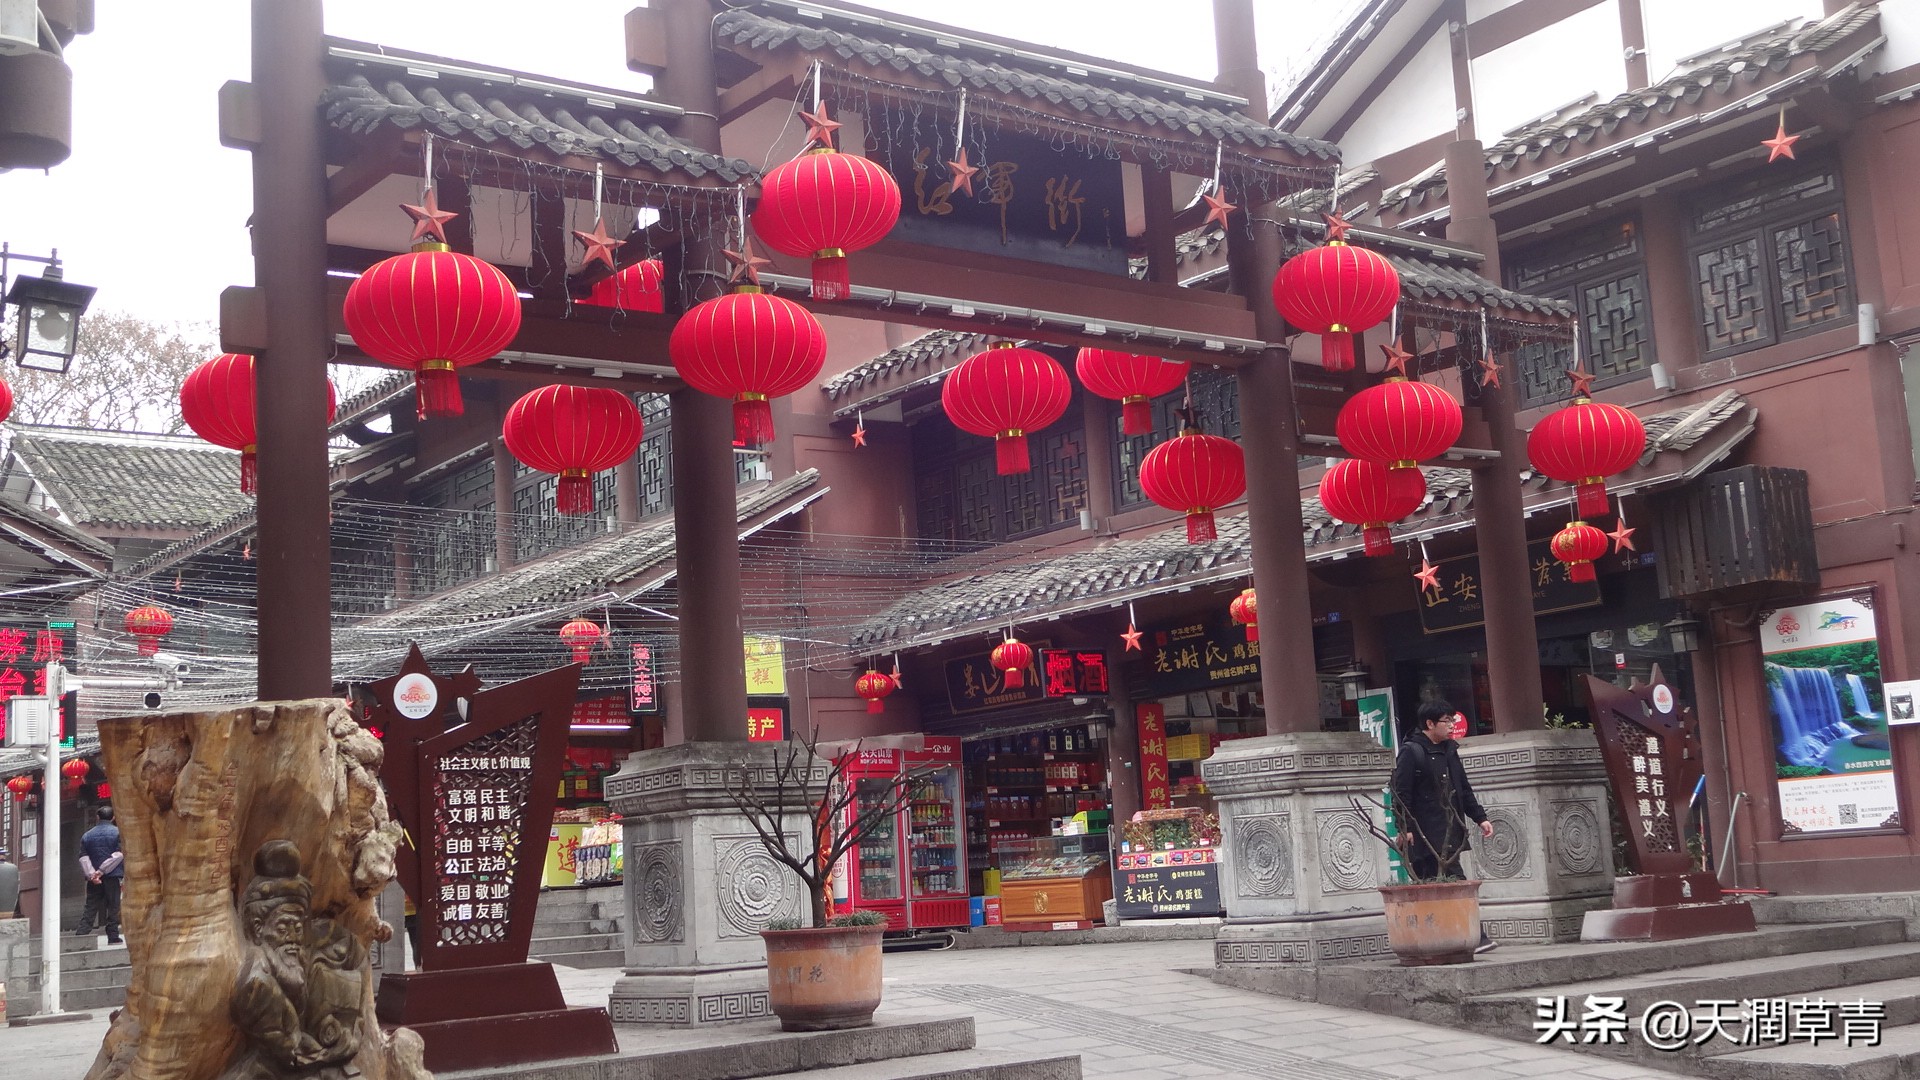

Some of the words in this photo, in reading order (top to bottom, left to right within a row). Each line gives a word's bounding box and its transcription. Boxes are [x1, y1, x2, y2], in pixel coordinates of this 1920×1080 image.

[632, 647, 653, 709] 遵义土特产
[1046, 652, 1107, 694] 烟酒
[440, 757, 531, 771] 社会主义核心价值观
[1645, 737, 1669, 817] 遵道行义
[448, 789, 477, 805] 富强
[480, 788, 509, 805] 民主
[1632, 755, 1656, 838] 醉美遵义
[448, 808, 477, 823] 文明
[481, 806, 511, 822] 和谐
[445, 837, 472, 853] 自由
[477, 836, 505, 852] 平等
[445, 858, 474, 874] 公正
[477, 856, 506, 872] 法治
[441, 884, 470, 901] 爱国
[475, 884, 506, 900] 敬业
[442, 904, 472, 921] 诚信
[476, 902, 504, 920] 友善
